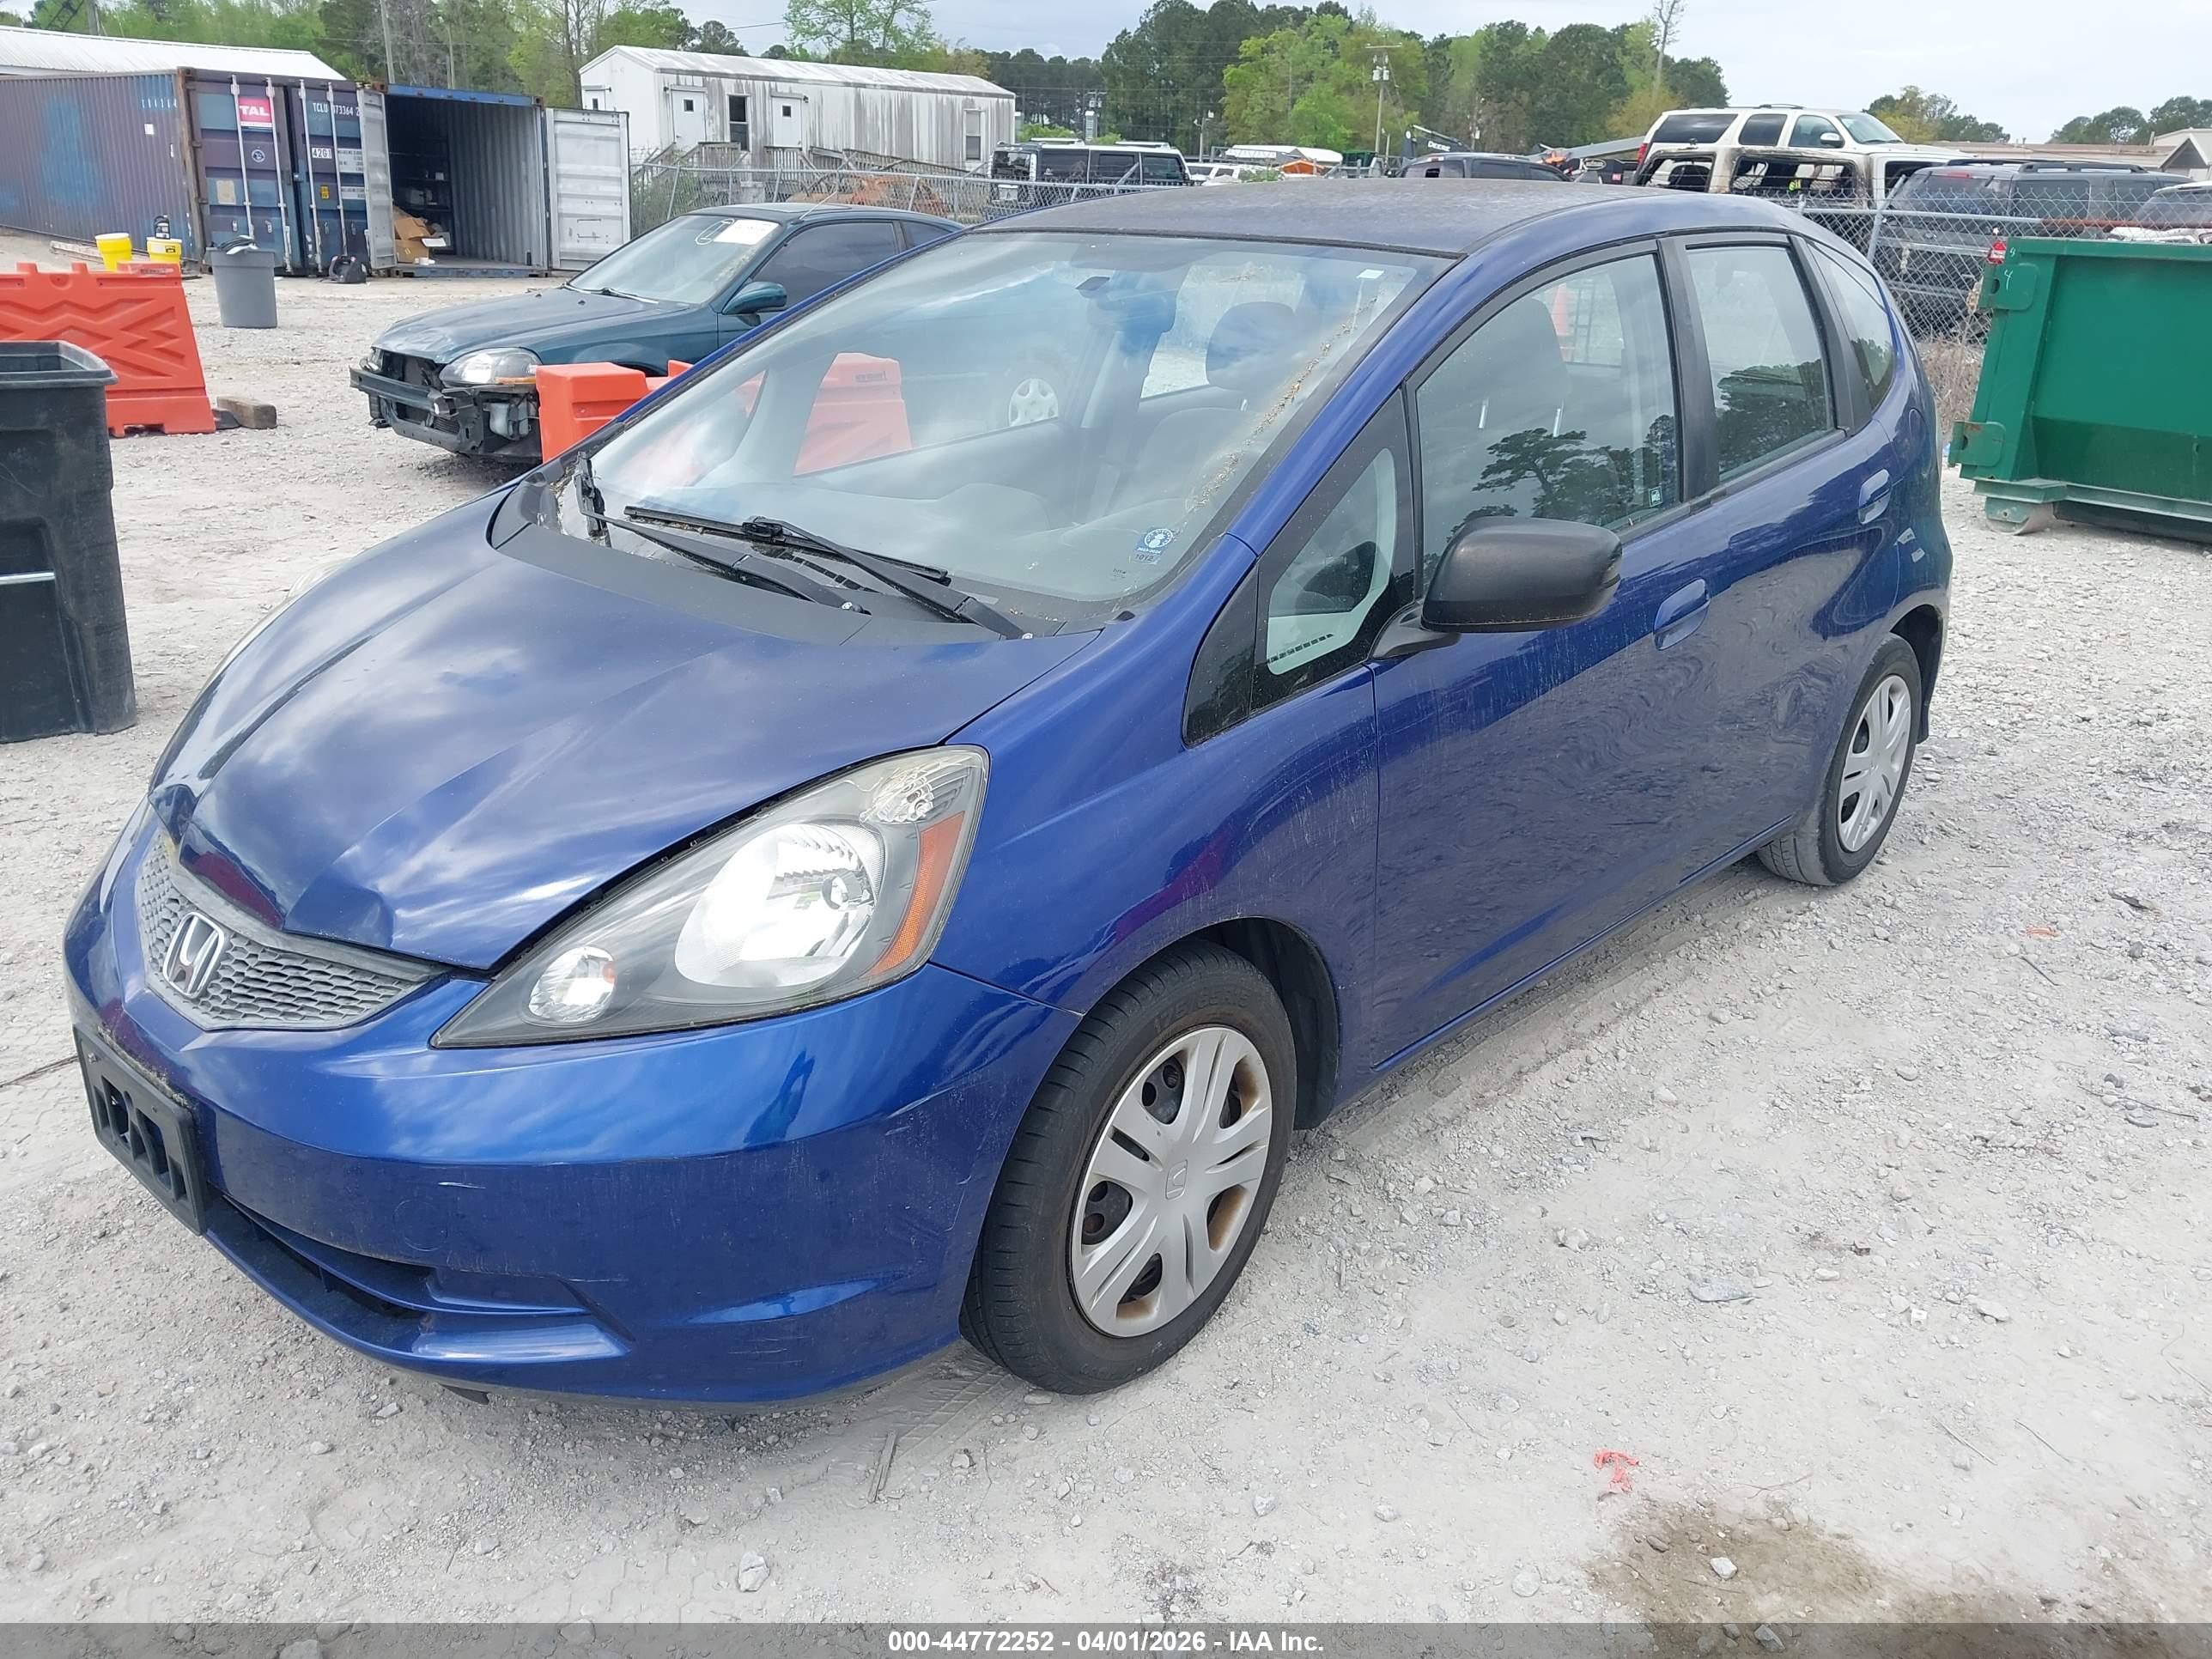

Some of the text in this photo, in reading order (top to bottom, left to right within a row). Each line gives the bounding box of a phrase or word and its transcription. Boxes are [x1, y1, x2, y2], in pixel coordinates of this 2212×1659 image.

[240, 105, 270, 116] TAL
[313, 102, 328, 113] TCLU
[1428, 140, 1451, 152] DEERE
